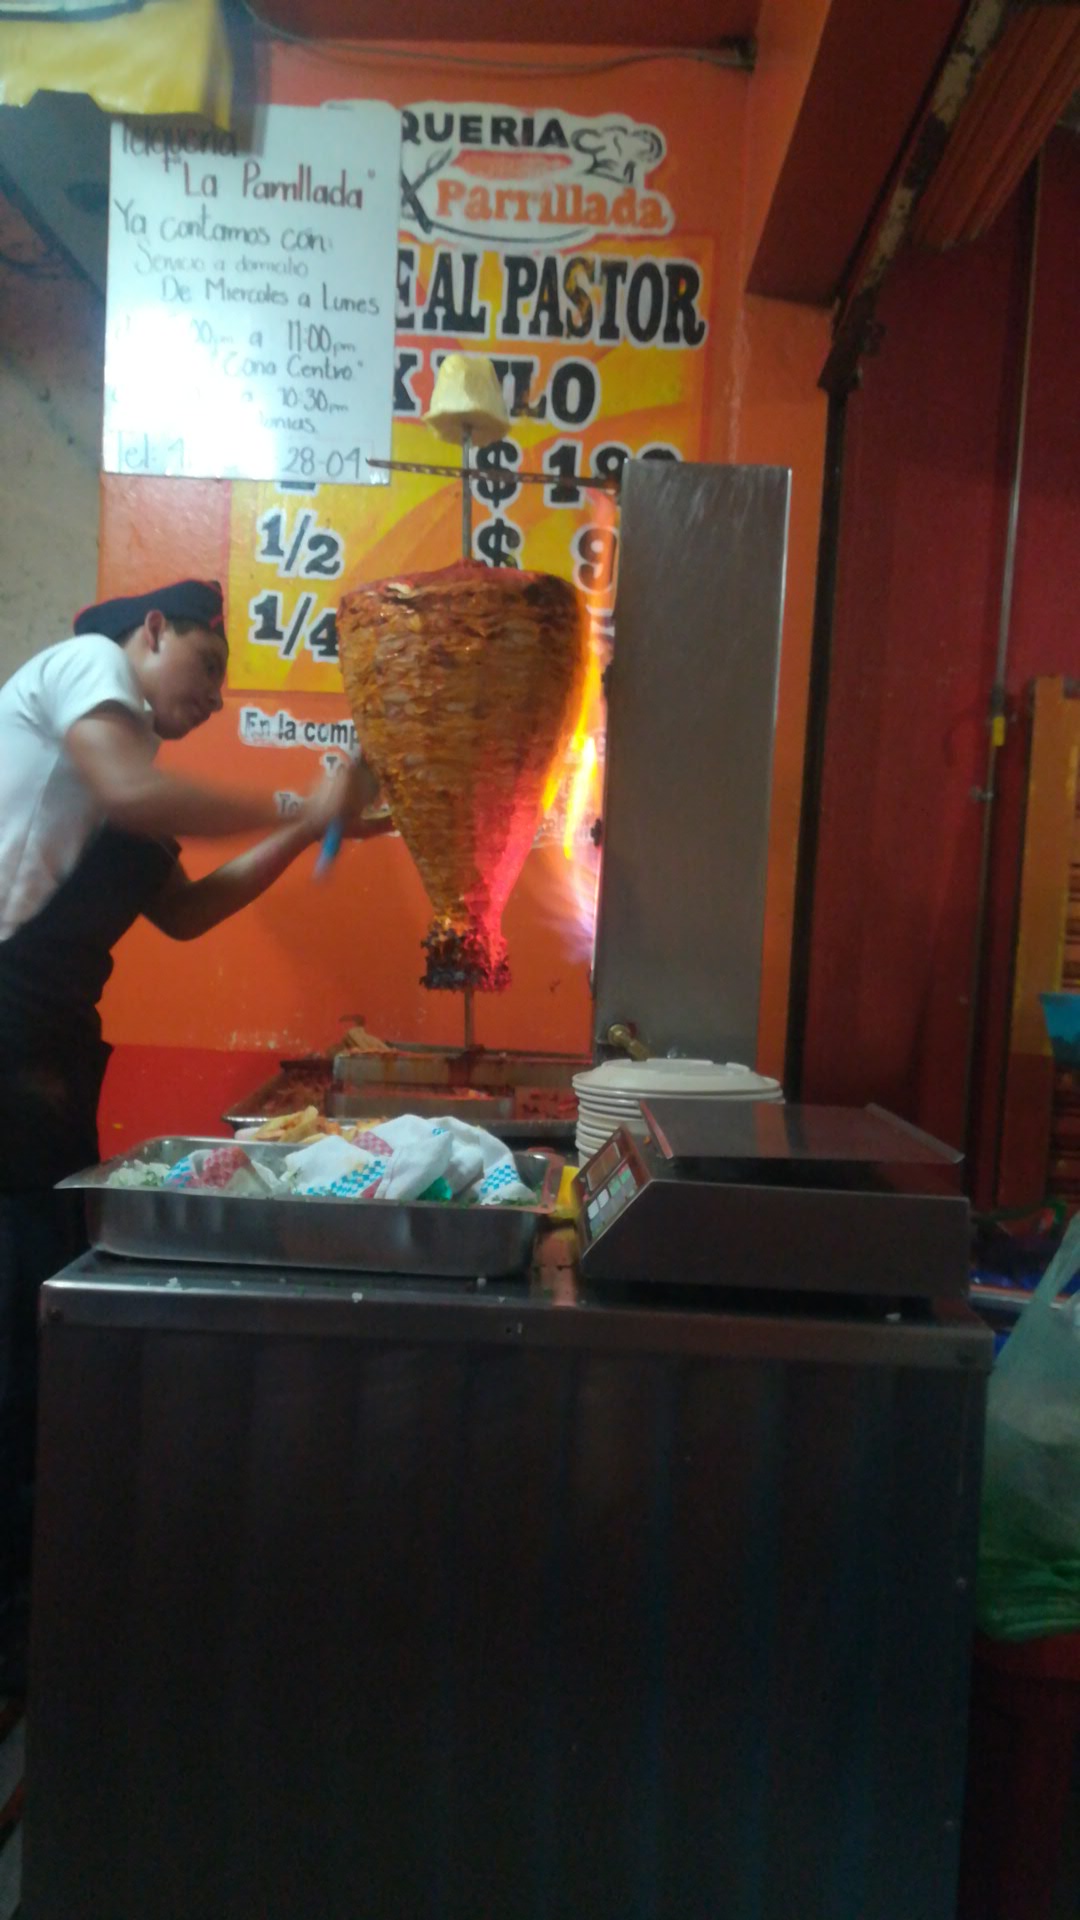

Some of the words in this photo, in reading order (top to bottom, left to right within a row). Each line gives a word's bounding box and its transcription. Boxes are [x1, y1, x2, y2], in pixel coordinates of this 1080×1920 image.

[114, 199, 147, 235] Ya
[435, 179, 669, 231] Parrillada
[422, 250, 486, 335] AL
[502, 254, 707, 347] PASTOR
[394, 353, 596, 424] KLO
[260, 514, 341, 575] 1/2
[254, 595, 339, 656] 1/4
